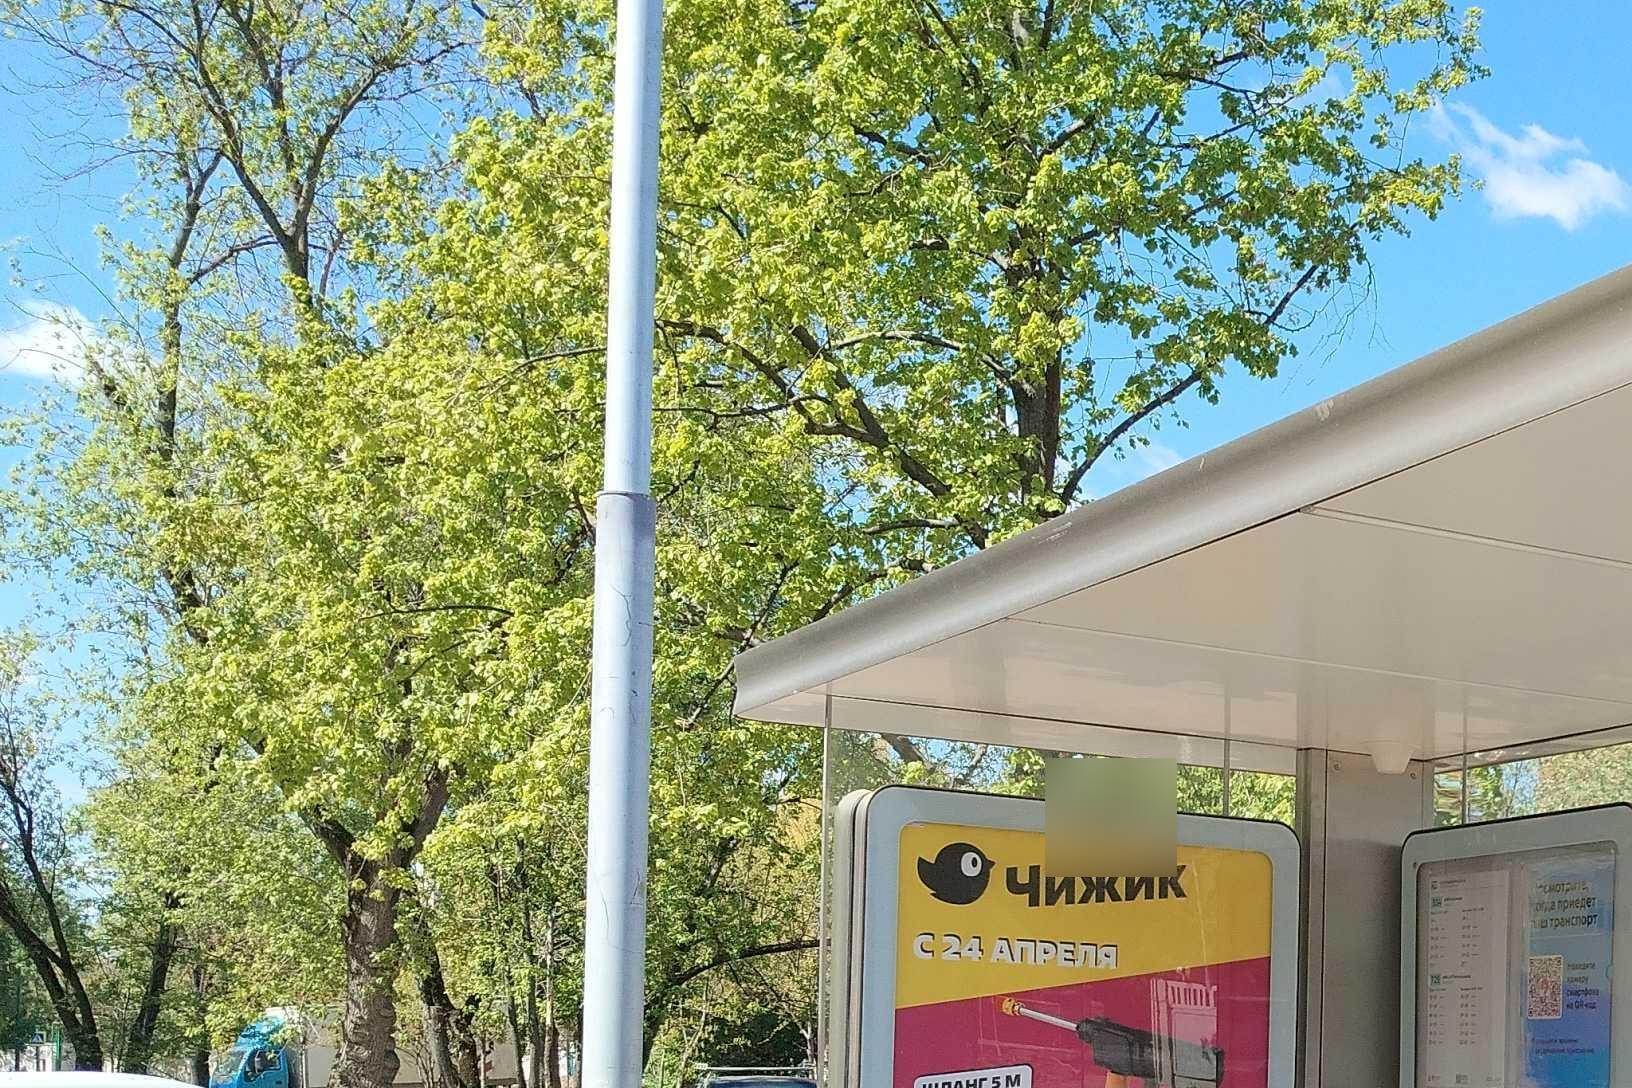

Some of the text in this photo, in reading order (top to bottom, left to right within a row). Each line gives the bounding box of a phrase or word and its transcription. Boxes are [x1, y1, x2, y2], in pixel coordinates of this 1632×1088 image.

[913, 932, 1118, 969] С 24 АПРЕЛЯ
[1005, 1073, 1022, 1088] М
